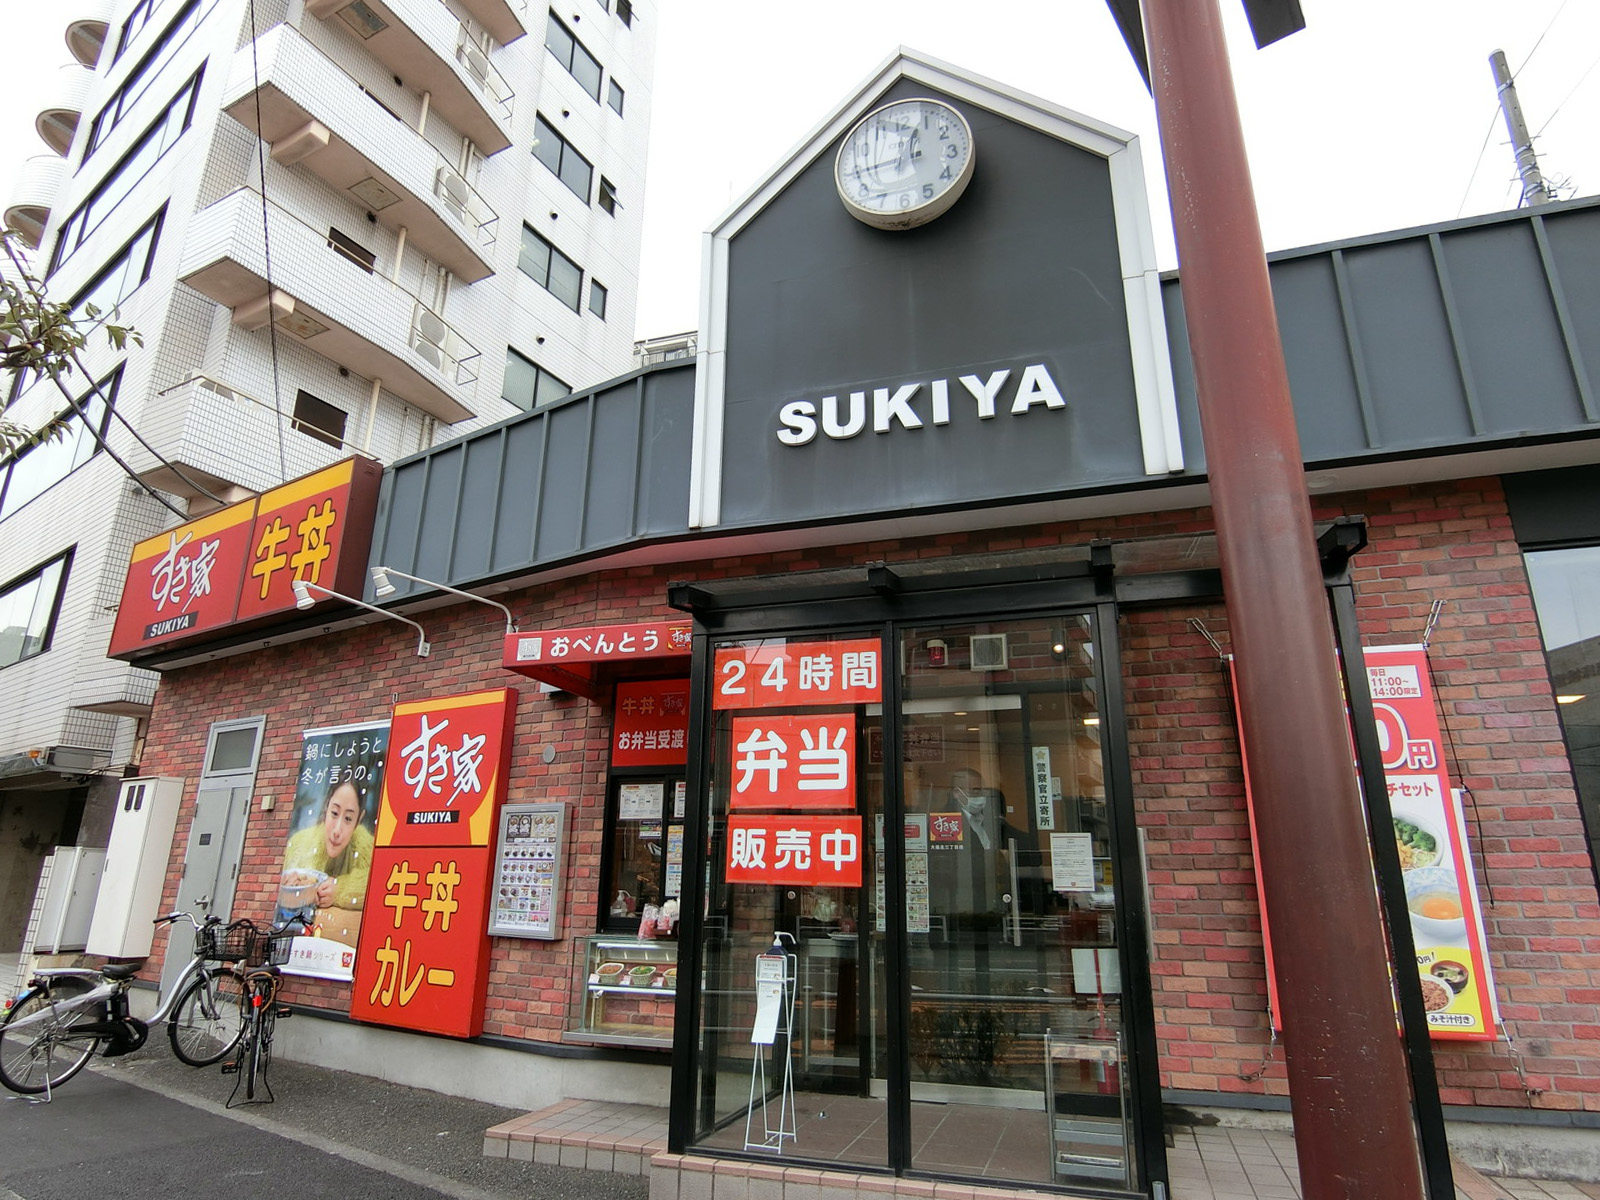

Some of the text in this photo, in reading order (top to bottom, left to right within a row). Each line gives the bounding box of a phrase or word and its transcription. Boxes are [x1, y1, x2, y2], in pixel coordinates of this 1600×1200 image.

[896, 115, 911, 133] 12
[939, 125, 950, 140] 2
[946, 144, 958, 158] 3
[939, 165, 953, 180] 4
[876, 193, 889, 209] 7
[900, 193, 911, 208] 6
[922, 183, 934, 199] 5
[776, 363, 1066, 446] SUKIYA
[252, 499, 337, 600] 牛丼
[151, 531, 221, 613] すき家
[150, 616, 190, 638] SUKIYA
[550, 630, 660, 657] おべんとう
[721, 651, 877, 695] 24時間
[622, 696, 656, 717] 牛丼
[304, 737, 382, 760] 鍋にしようと
[736, 727, 848, 793] 弁当
[401, 714, 486, 807] すき家
[301, 765, 373, 785] 冬が言うの。
[1036, 762, 1051, 827] 警察官立寄所
[413, 811, 452, 823] SUKIYA
[730, 828, 857, 871] 販売中
[384, 860, 462, 932] 牛丼
[370, 935, 455, 1007] カレー
